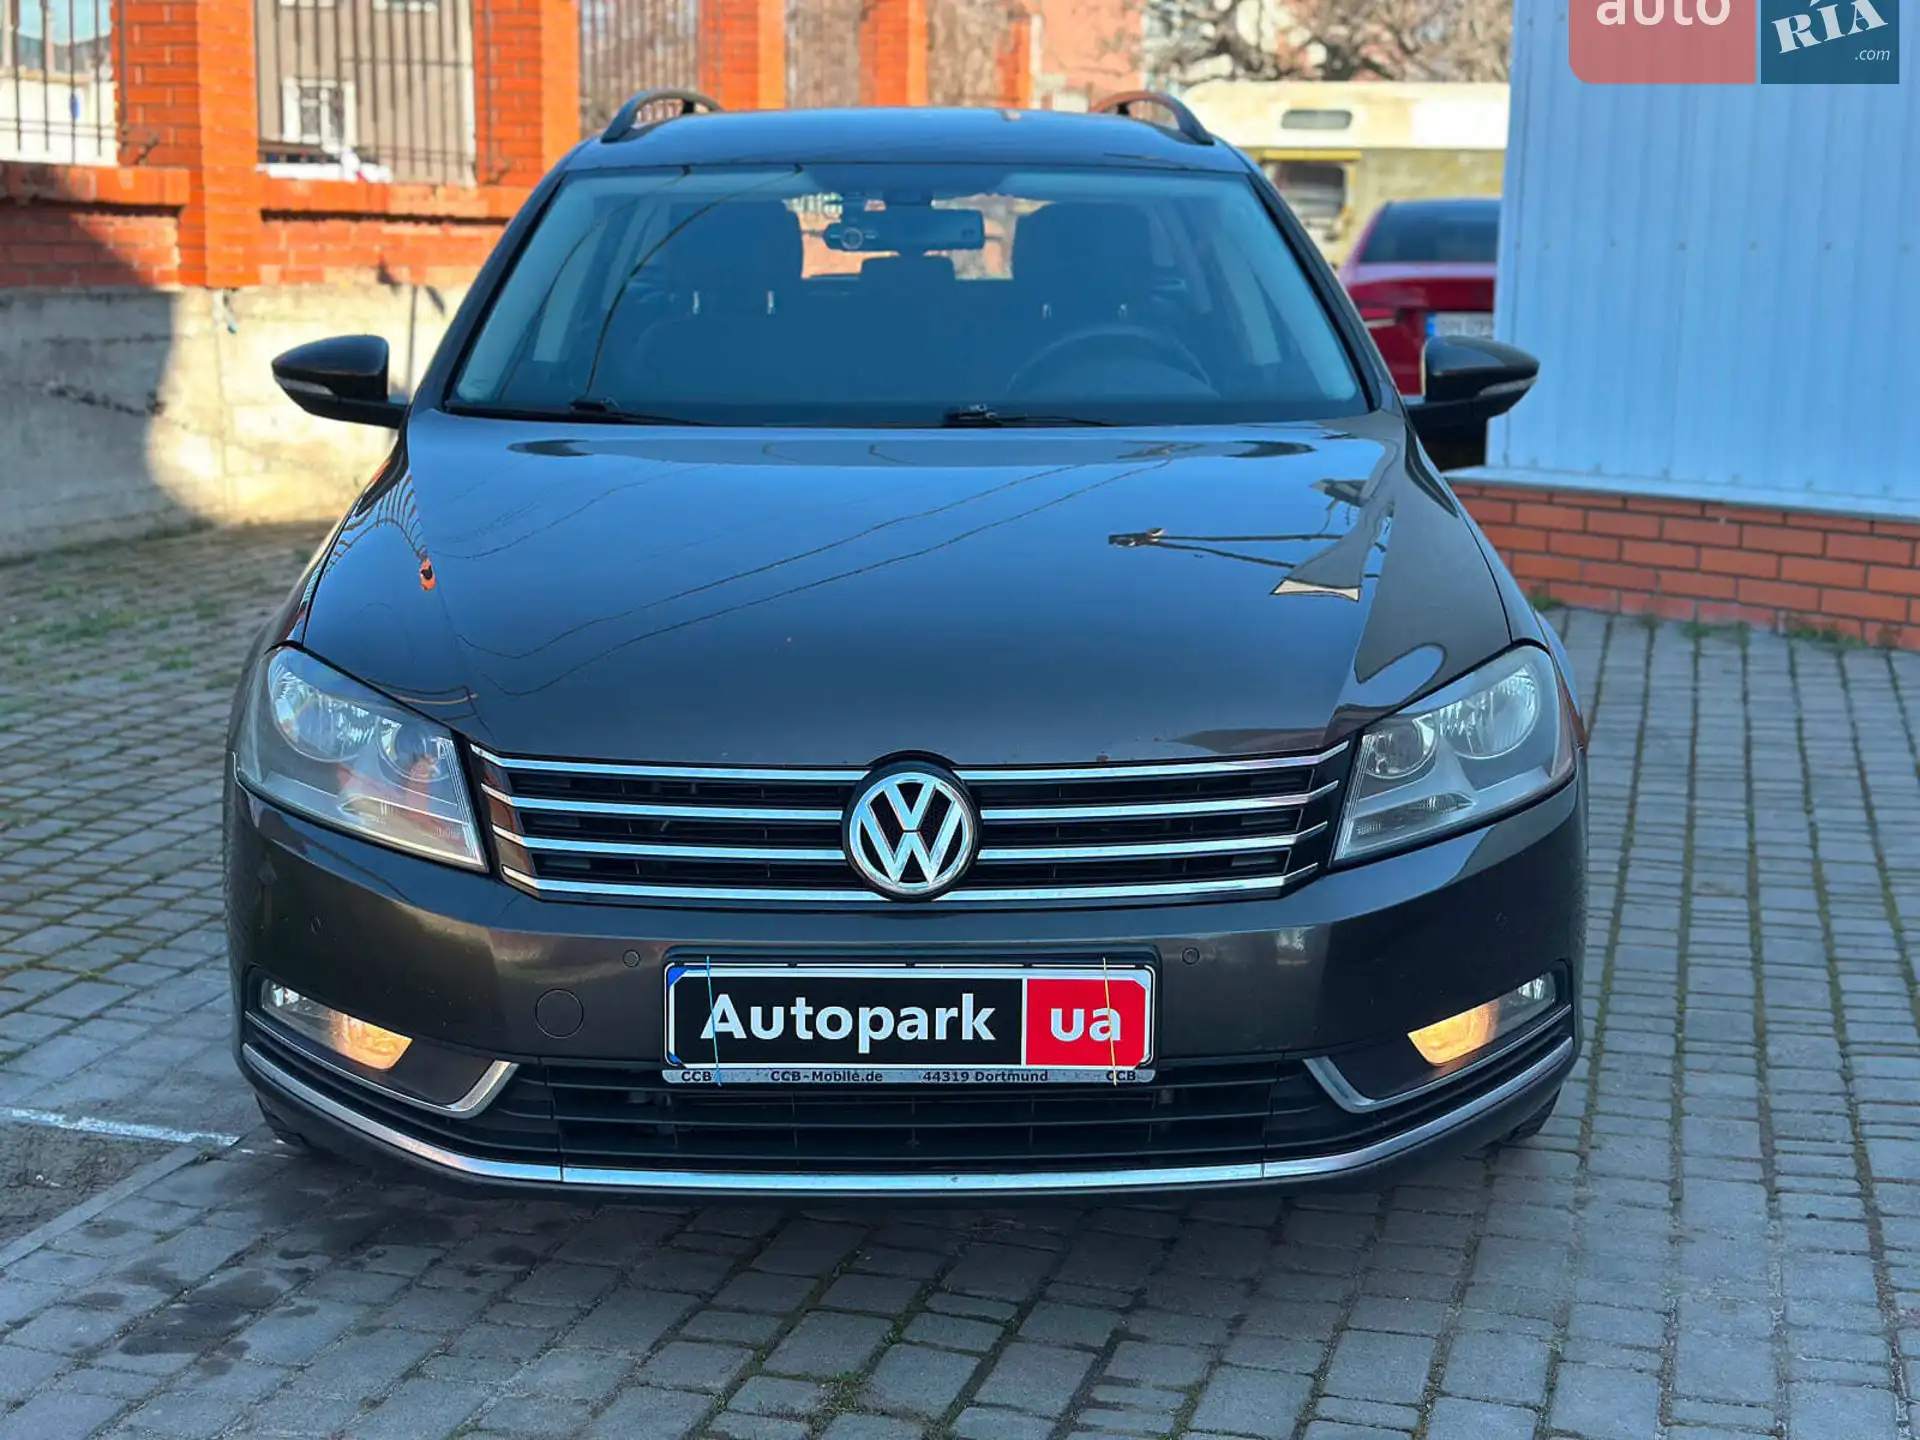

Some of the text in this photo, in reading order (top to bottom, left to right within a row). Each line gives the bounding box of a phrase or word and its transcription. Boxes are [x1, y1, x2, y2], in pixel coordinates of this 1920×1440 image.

[701, 993, 1121, 1053] Autopark ua
[681, 1070, 712, 1082] CCB
[922, 1070, 969, 1082] 44319
[975, 1070, 1048, 1082] Dortmund
[1106, 1070, 1136, 1082] CCB
